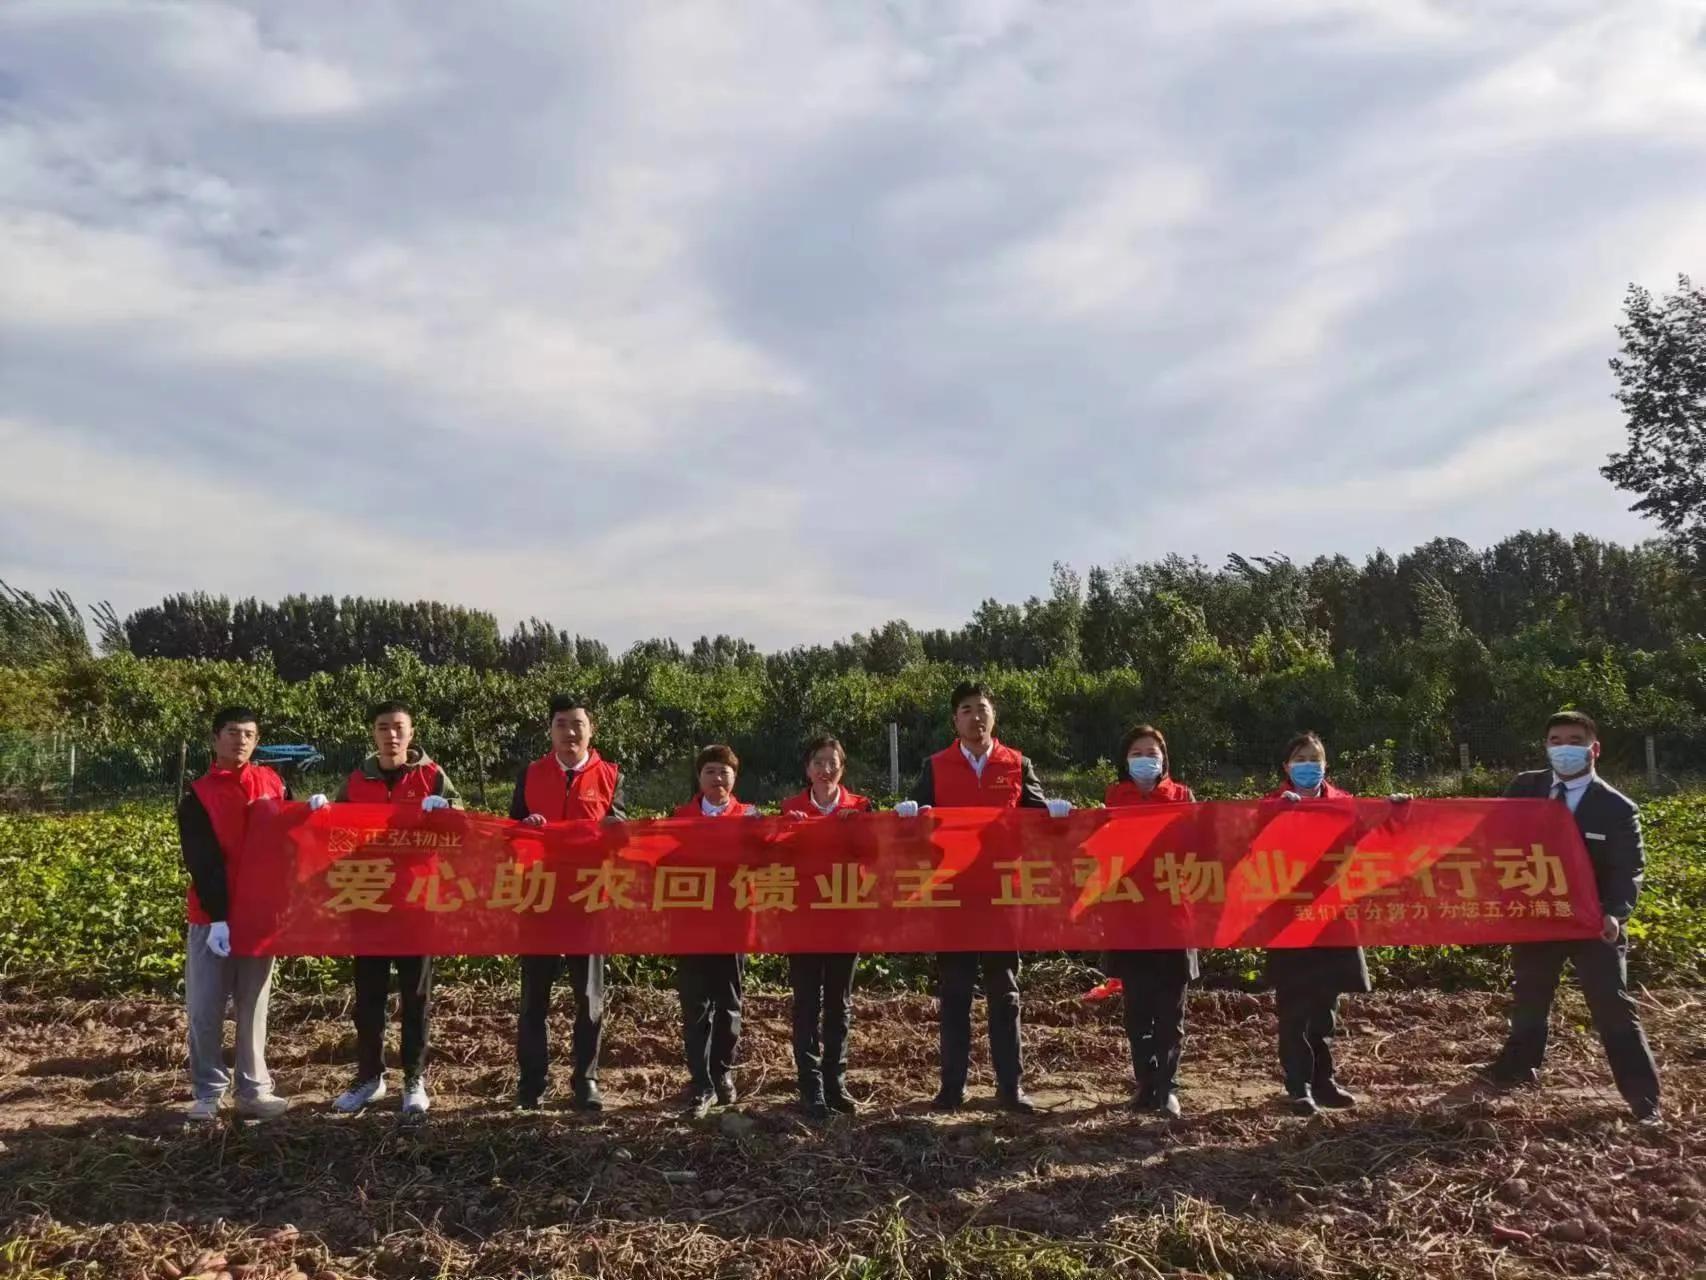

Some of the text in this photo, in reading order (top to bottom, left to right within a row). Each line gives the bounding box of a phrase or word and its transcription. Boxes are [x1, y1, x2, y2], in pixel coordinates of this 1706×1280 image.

[362, 828, 464, 848] 正弘物业
[325, 843, 1570, 914] 爱心助农回馈业主 正弘物业在行动
[1437, 898, 1575, 919] 为您五分满意
